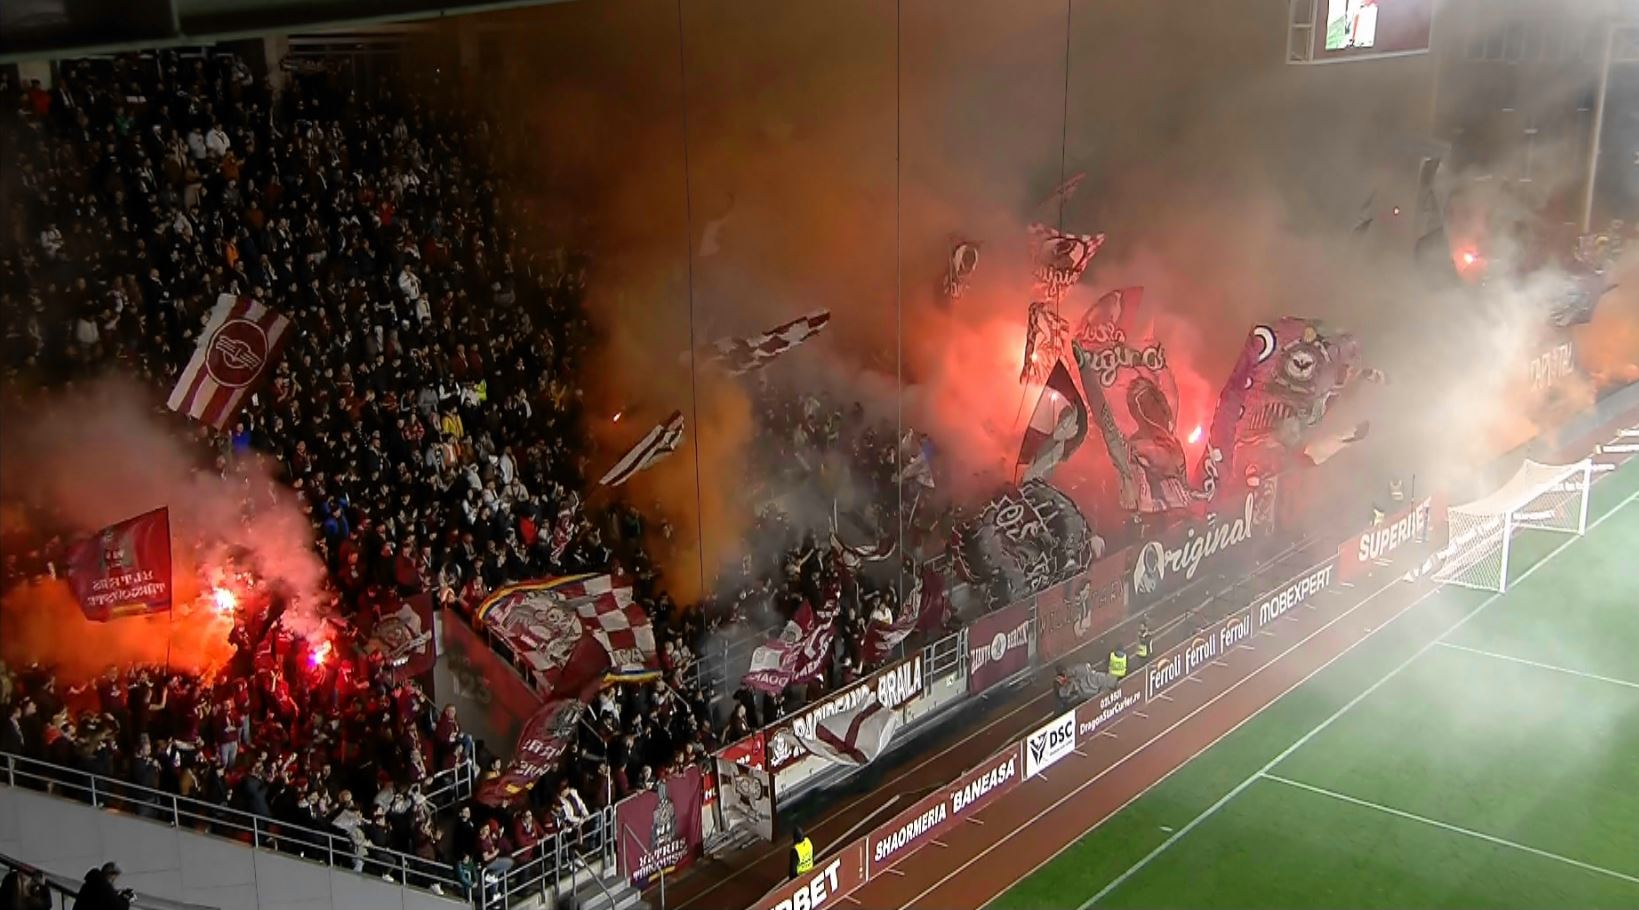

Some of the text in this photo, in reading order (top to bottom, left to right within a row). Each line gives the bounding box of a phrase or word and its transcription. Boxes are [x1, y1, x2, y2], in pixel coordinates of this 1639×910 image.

[1259, 564, 1334, 627] MOBEXPERT
[1149, 615, 1250, 697] Ferroli Ferroli Ferroli
[1049, 721, 1073, 749] DSC
[874, 802, 947, 861] SHAORMERIA
